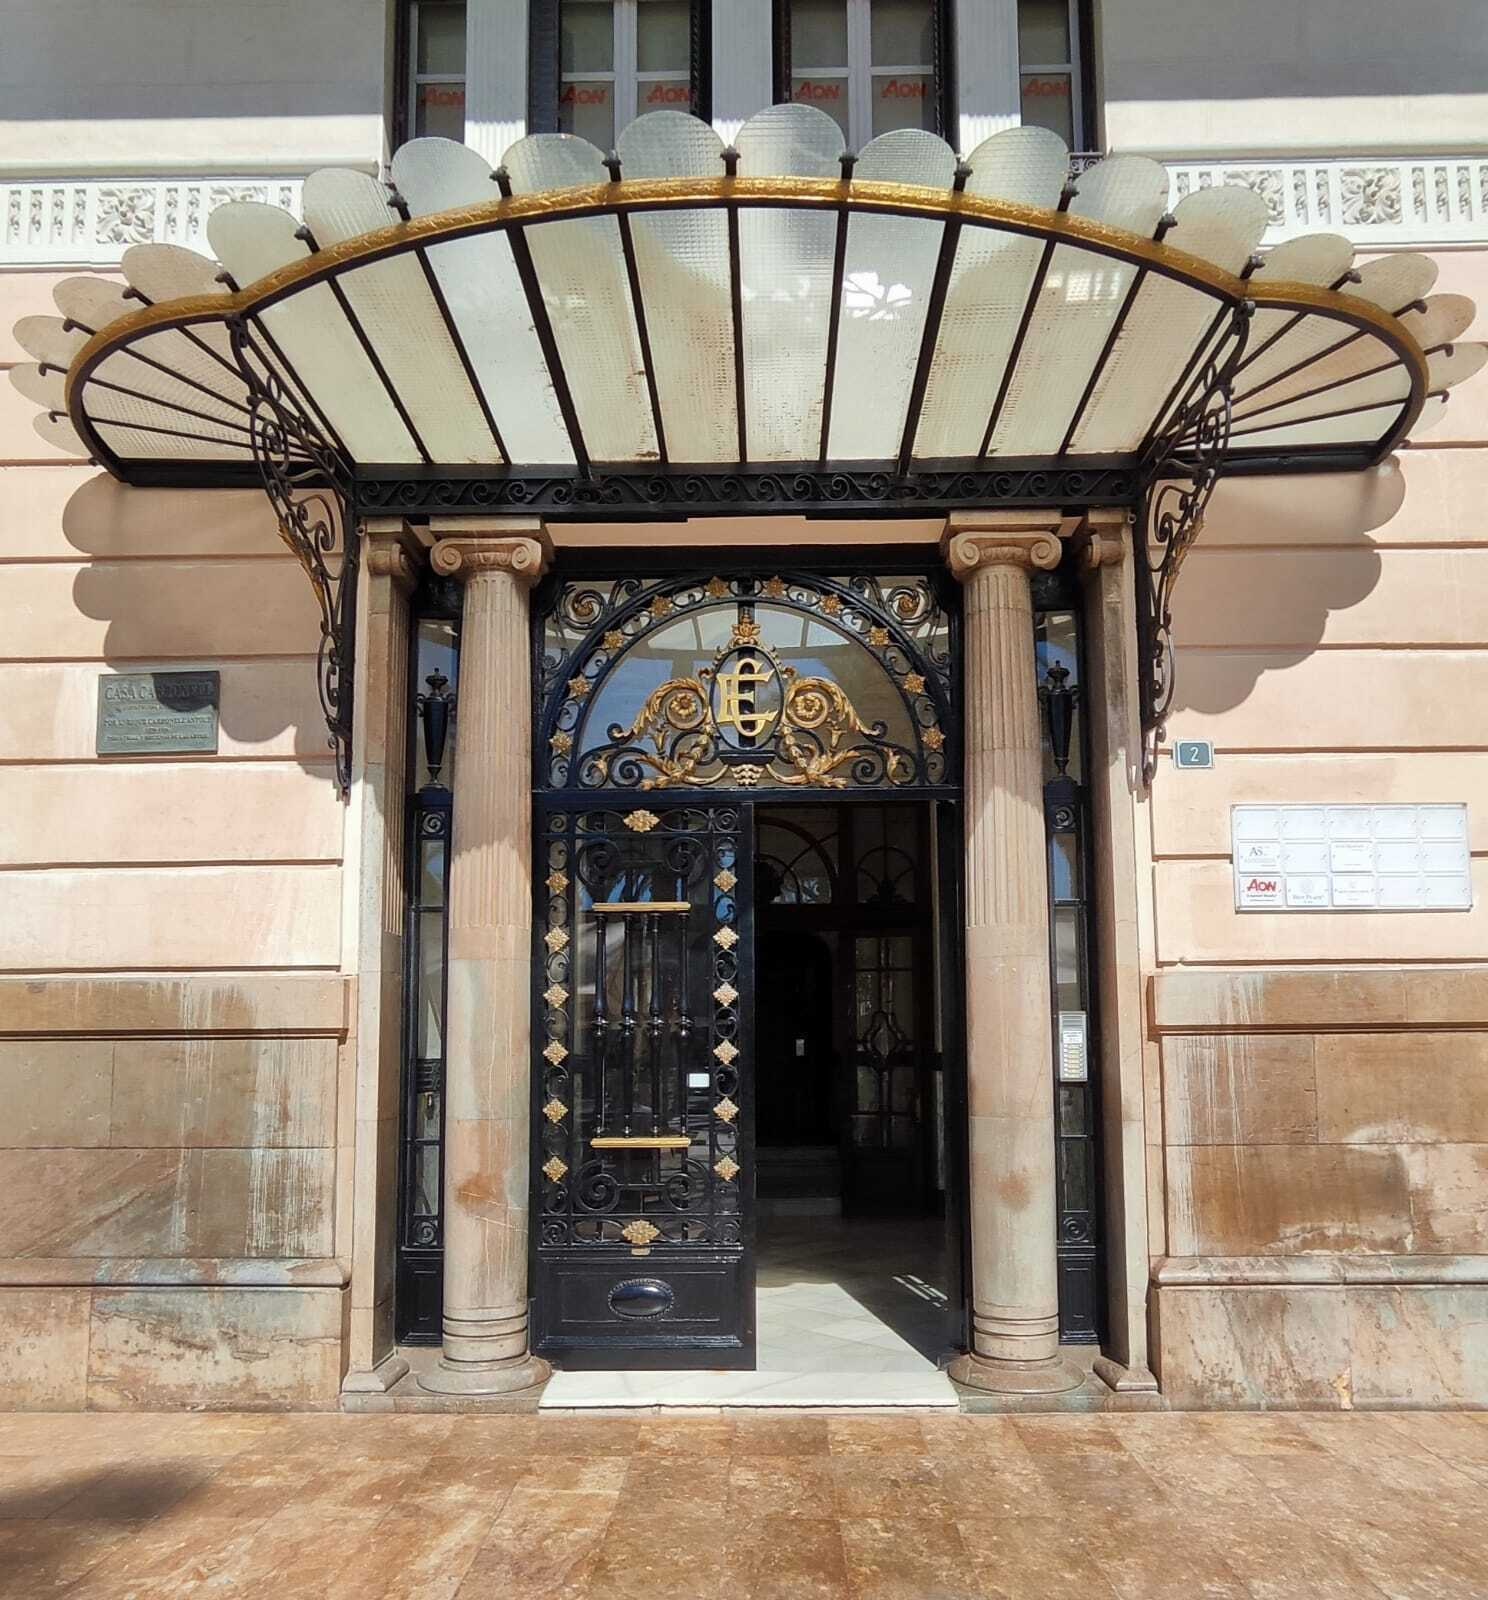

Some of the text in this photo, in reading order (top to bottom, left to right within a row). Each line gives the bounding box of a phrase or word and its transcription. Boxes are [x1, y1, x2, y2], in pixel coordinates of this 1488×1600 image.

[561, 84, 607, 104] AON
[796, 81, 840, 99] AON
[882, 79, 928, 97] AON
[104, 683, 212, 700] CASA CAONELL
[1189, 746, 1200, 762] 2
[1246, 878, 1277, 892] AON
